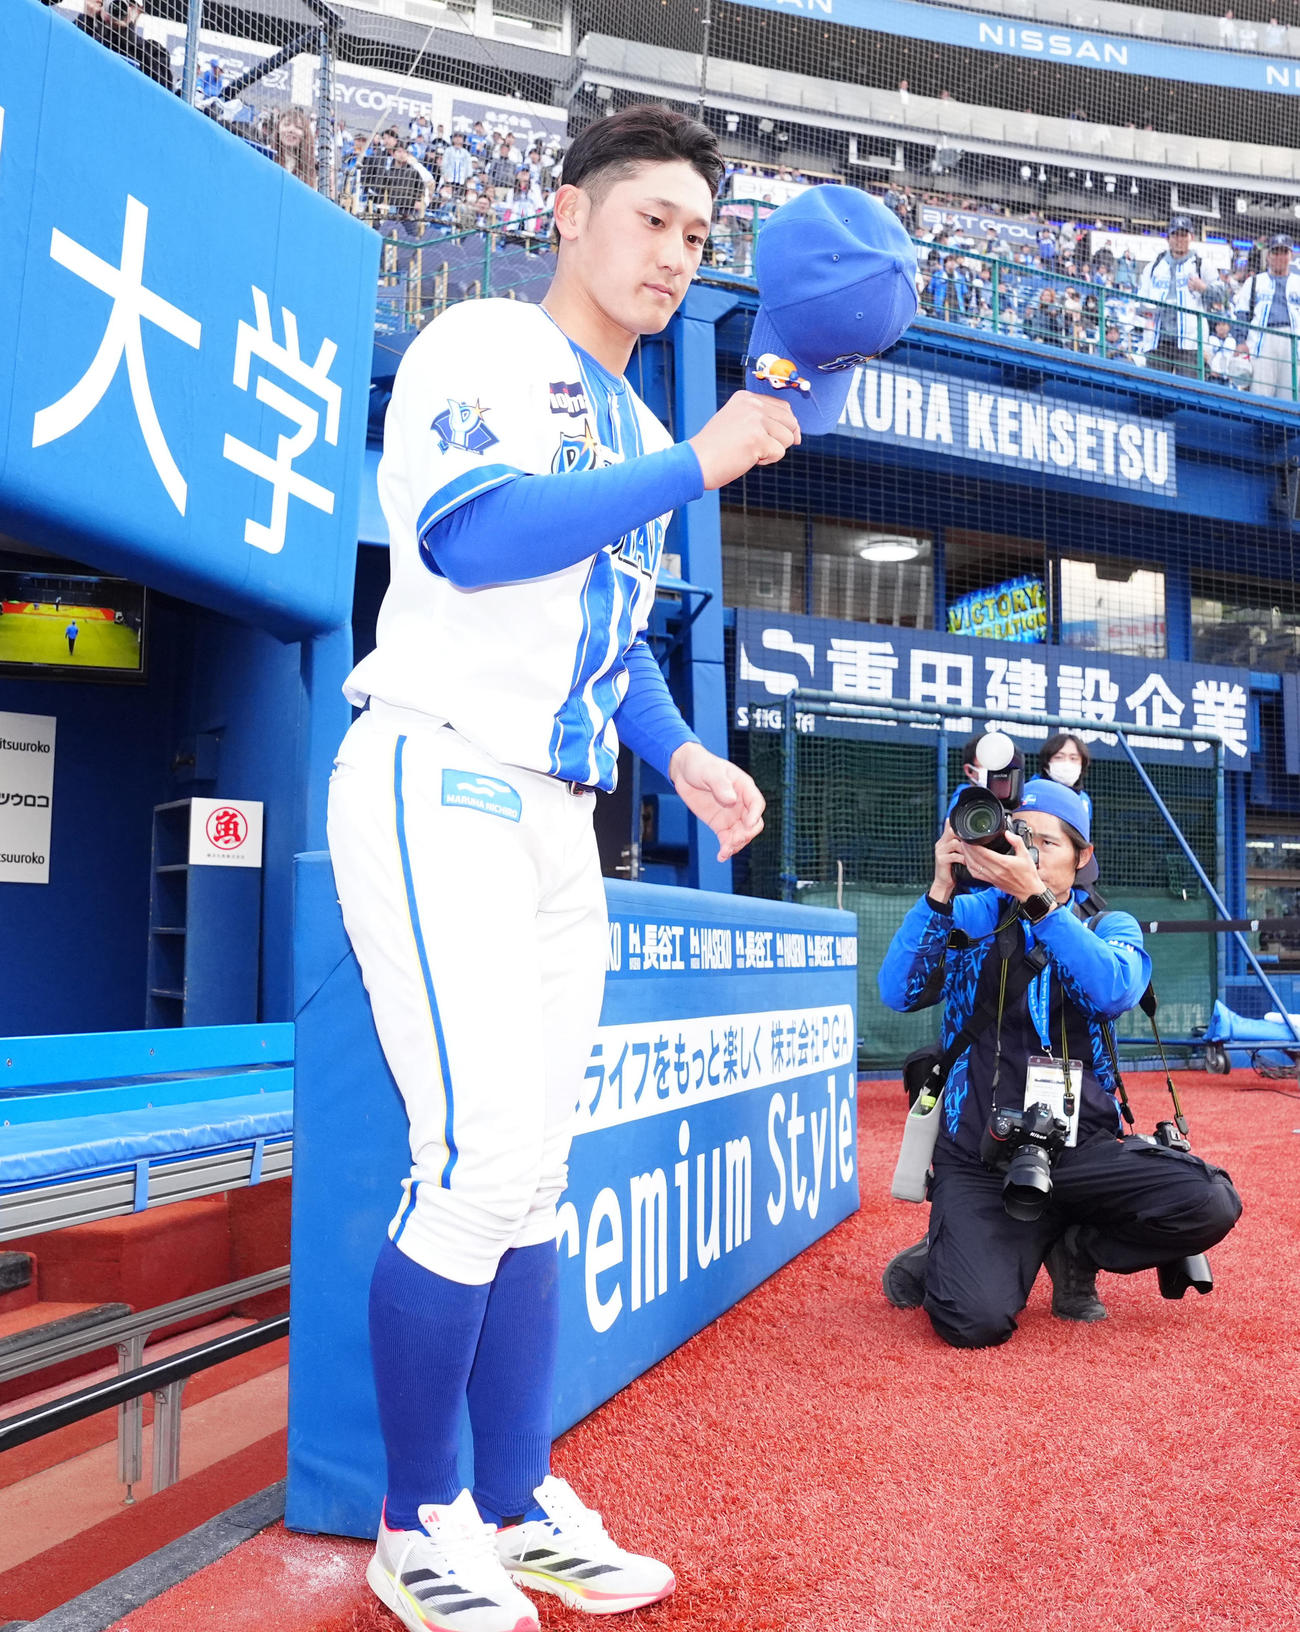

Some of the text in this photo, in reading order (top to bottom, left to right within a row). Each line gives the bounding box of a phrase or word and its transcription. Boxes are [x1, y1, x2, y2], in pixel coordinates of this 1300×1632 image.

[979, 22, 1128, 65] NISSAN
[32, 193, 342, 555] 大学
[967, 390, 1169, 486] KENSETSU
[949, 584, 1040, 631] VICTORY
[826, 637, 1248, 759] 重田建設企業
[642, 924, 685, 970] 長谷工
[701, 927, 732, 969] HASEKO
[745, 931, 774, 968] 長谷工
[575, 1025, 762, 1117] ライフをもっと楽しく
[767, 1074, 854, 1226] Style
